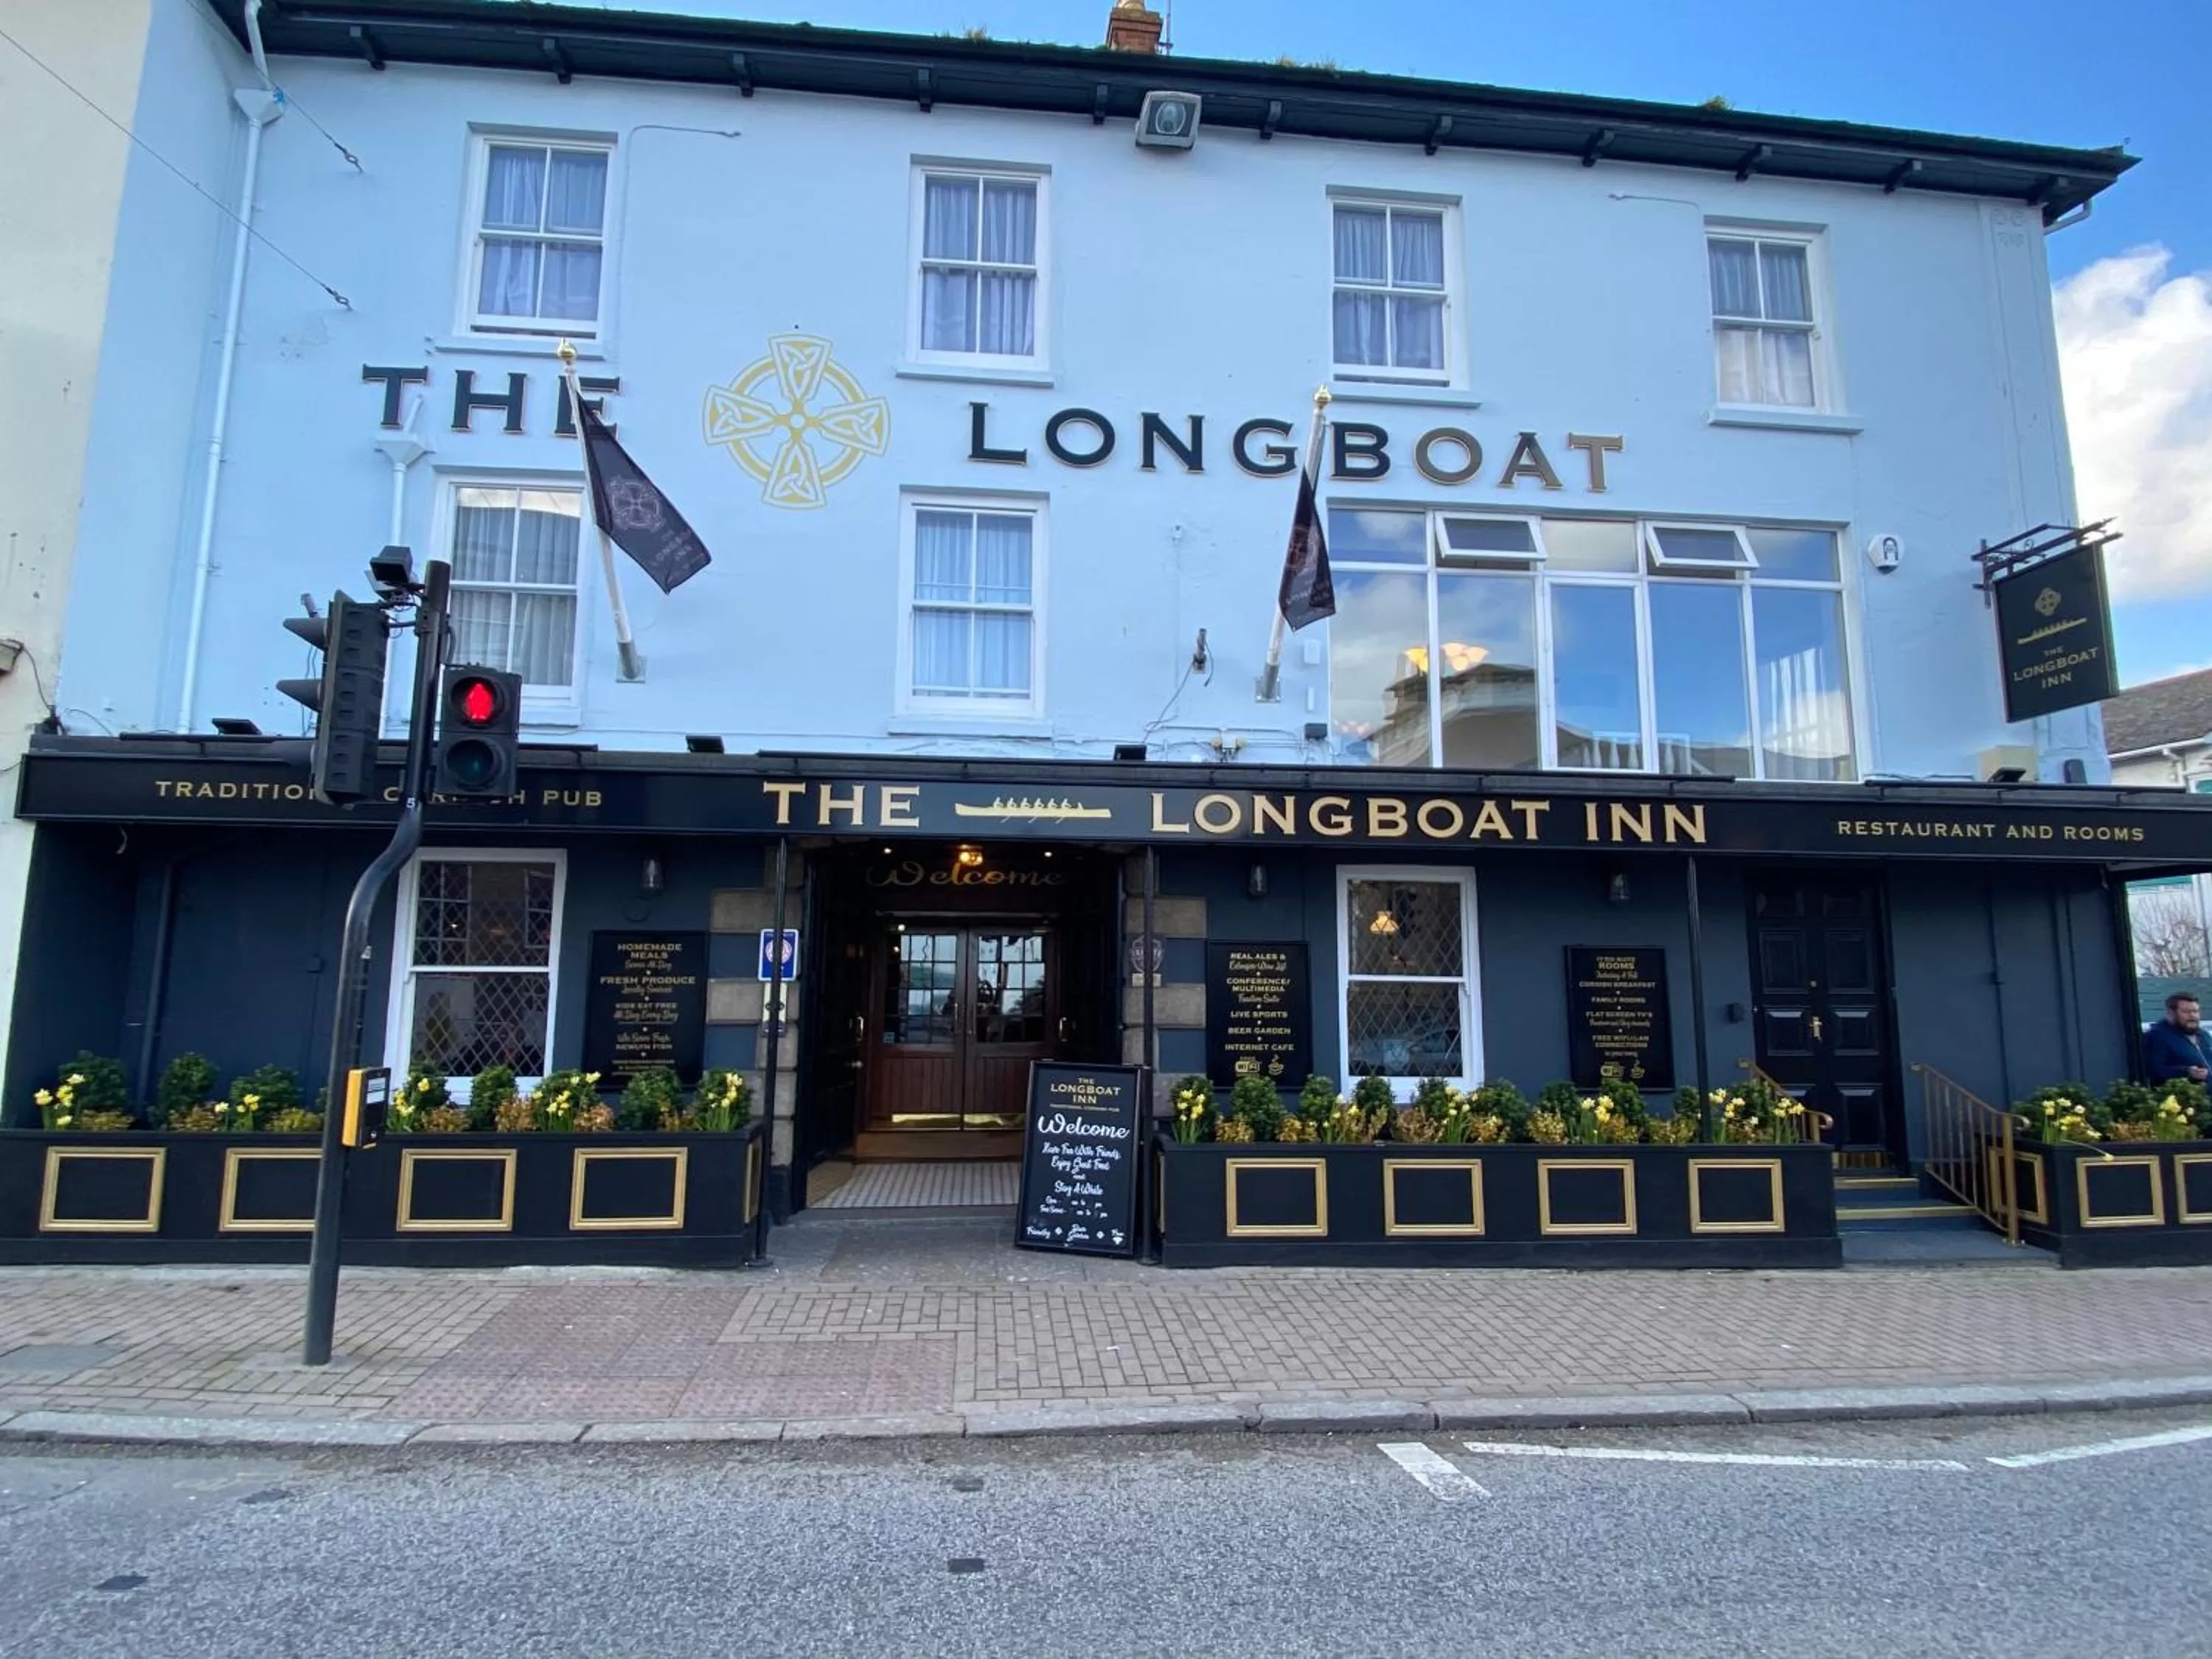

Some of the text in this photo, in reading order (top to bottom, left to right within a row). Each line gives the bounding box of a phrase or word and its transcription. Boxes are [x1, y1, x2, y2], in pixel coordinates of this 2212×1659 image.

[361, 364, 1624, 493] THE LONGBOAT
[2043, 646, 2064, 656] THE
[2013, 647, 2099, 682] LONGBOAT
[2042, 672, 2072, 689] INN
[156, 780, 317, 799] TRADITIO
[543, 790, 602, 807] PUB
[763, 781, 1707, 844] THE LONGBOAT INN
[1837, 821, 2145, 842] RESTAURANT AND ROOMS
[866, 860, 1067, 887] Welcome
[617, 943, 683, 951] HOMEMADE
[1599, 961, 1635, 970] ROOMS
[599, 975, 696, 984] FRESH PRODUCE
[1253, 1027, 1291, 1035] GARDEN
[1050, 1083, 1121, 1096] LONGBOAT
[1072, 1093, 1098, 1104] INN
[1037, 1113, 1130, 1139] Welcome
[1051, 1155, 1071, 1171] Enjoy
[1054, 1180, 1073, 1197] Stay
